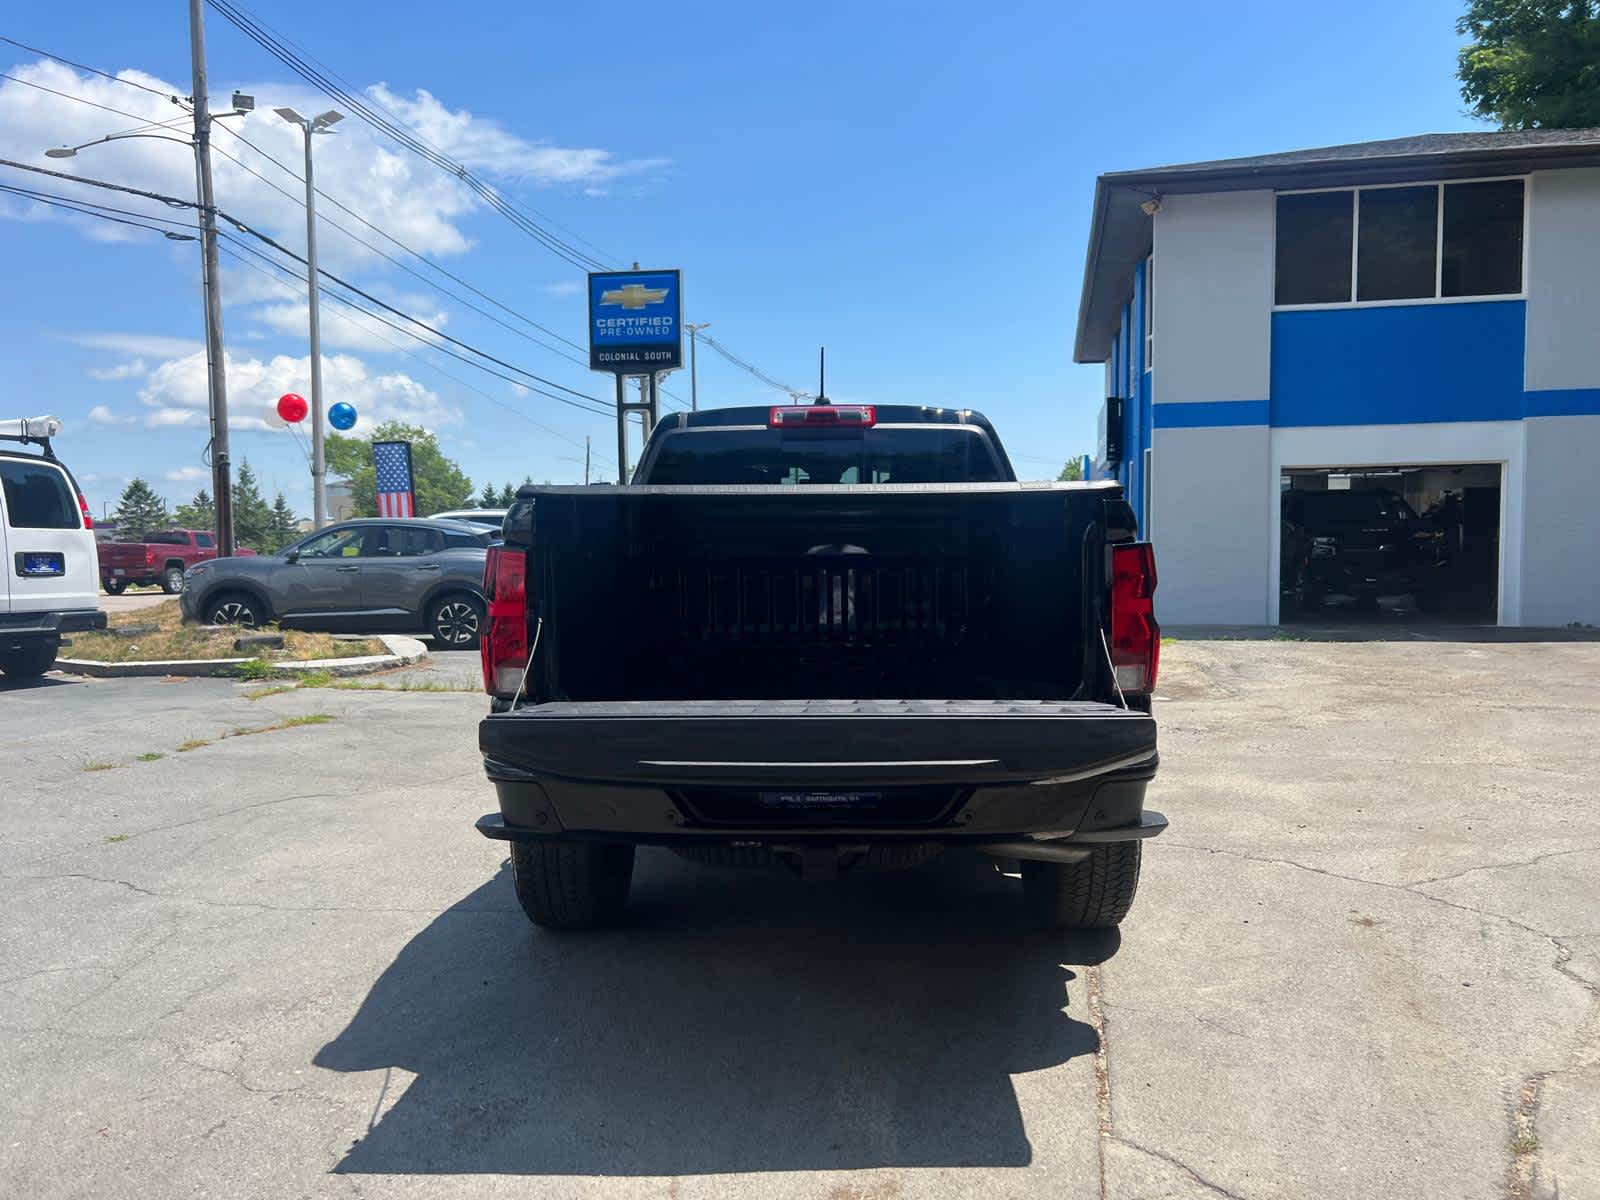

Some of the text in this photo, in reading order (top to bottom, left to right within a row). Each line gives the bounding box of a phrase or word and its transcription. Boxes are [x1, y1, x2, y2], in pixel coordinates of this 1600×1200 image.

[596, 317, 673, 327] CERTIFIED
[600, 327, 670, 336] PRE-OWNED
[600, 352, 672, 361] COLONIAL SOUTH
